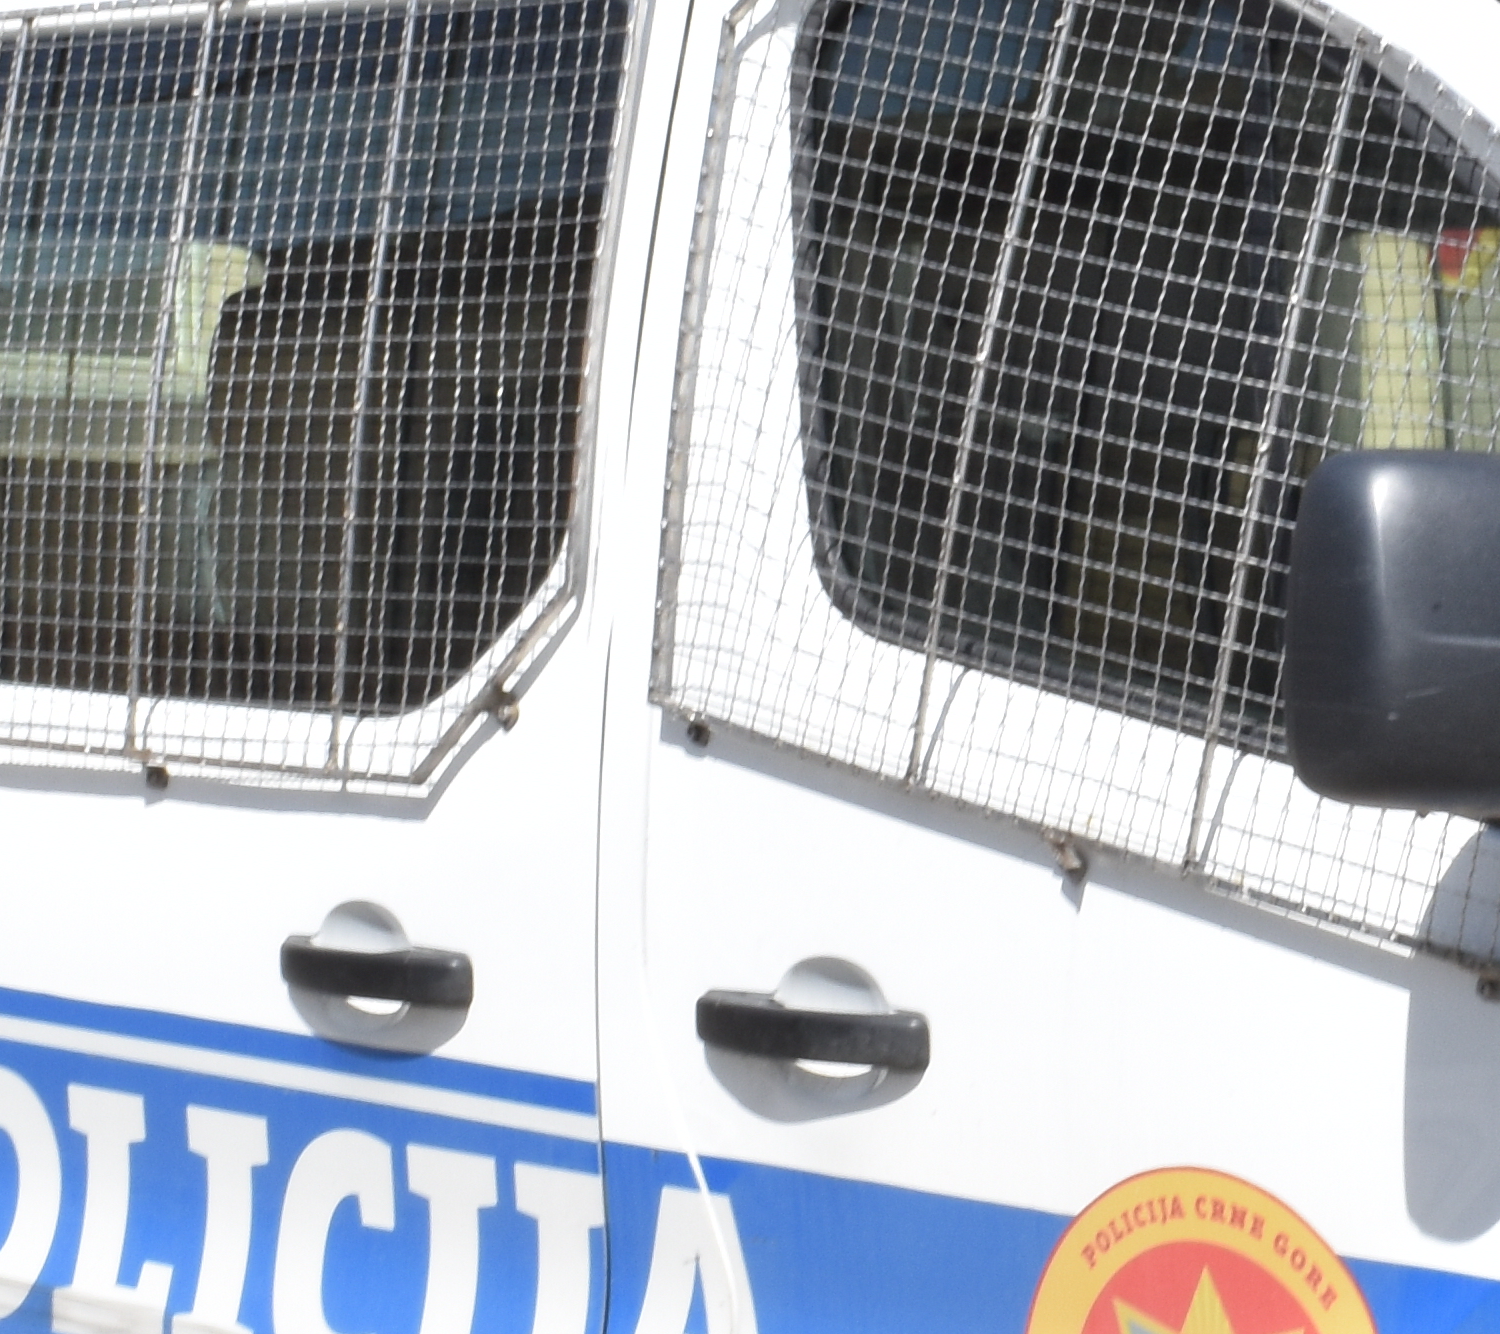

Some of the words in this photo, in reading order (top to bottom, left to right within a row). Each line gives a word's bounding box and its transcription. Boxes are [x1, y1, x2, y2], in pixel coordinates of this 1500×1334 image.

[1080, 1195, 1186, 1270] POLICIJA
[1194, 1196, 1265, 1240] CRNE
[1273, 1231, 1339, 1312] GORE
